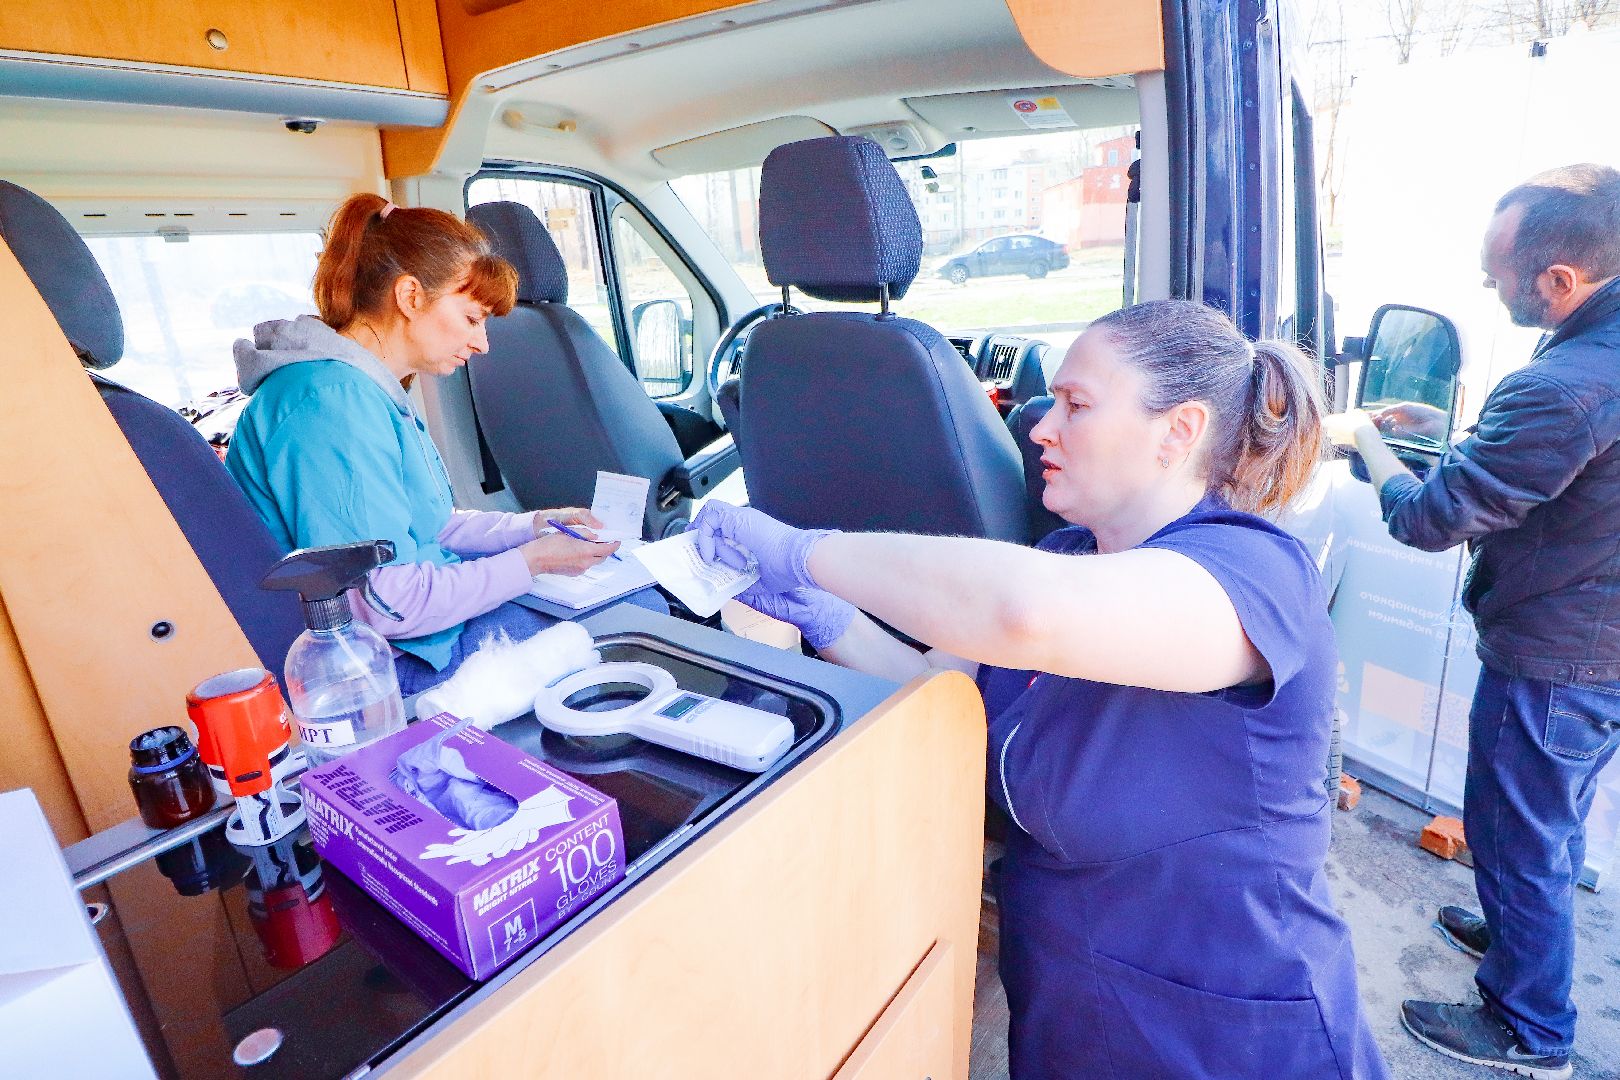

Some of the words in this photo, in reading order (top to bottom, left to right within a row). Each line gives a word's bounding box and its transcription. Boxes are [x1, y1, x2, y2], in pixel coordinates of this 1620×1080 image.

[304, 787, 354, 840] MATRIX
[545, 813, 610, 862] CONTENT
[473, 856, 541, 911] MATRIX
[550, 828, 616, 893] 100
[556, 859, 618, 910] GLOVES
[478, 893, 508, 917] BRIGHT
[509, 874, 539, 900] NITRILE
[558, 904, 574, 919] BY
[581, 870, 618, 902] COUNT
[503, 927, 528, 952] 7-8
[504, 914, 523, 940] M
